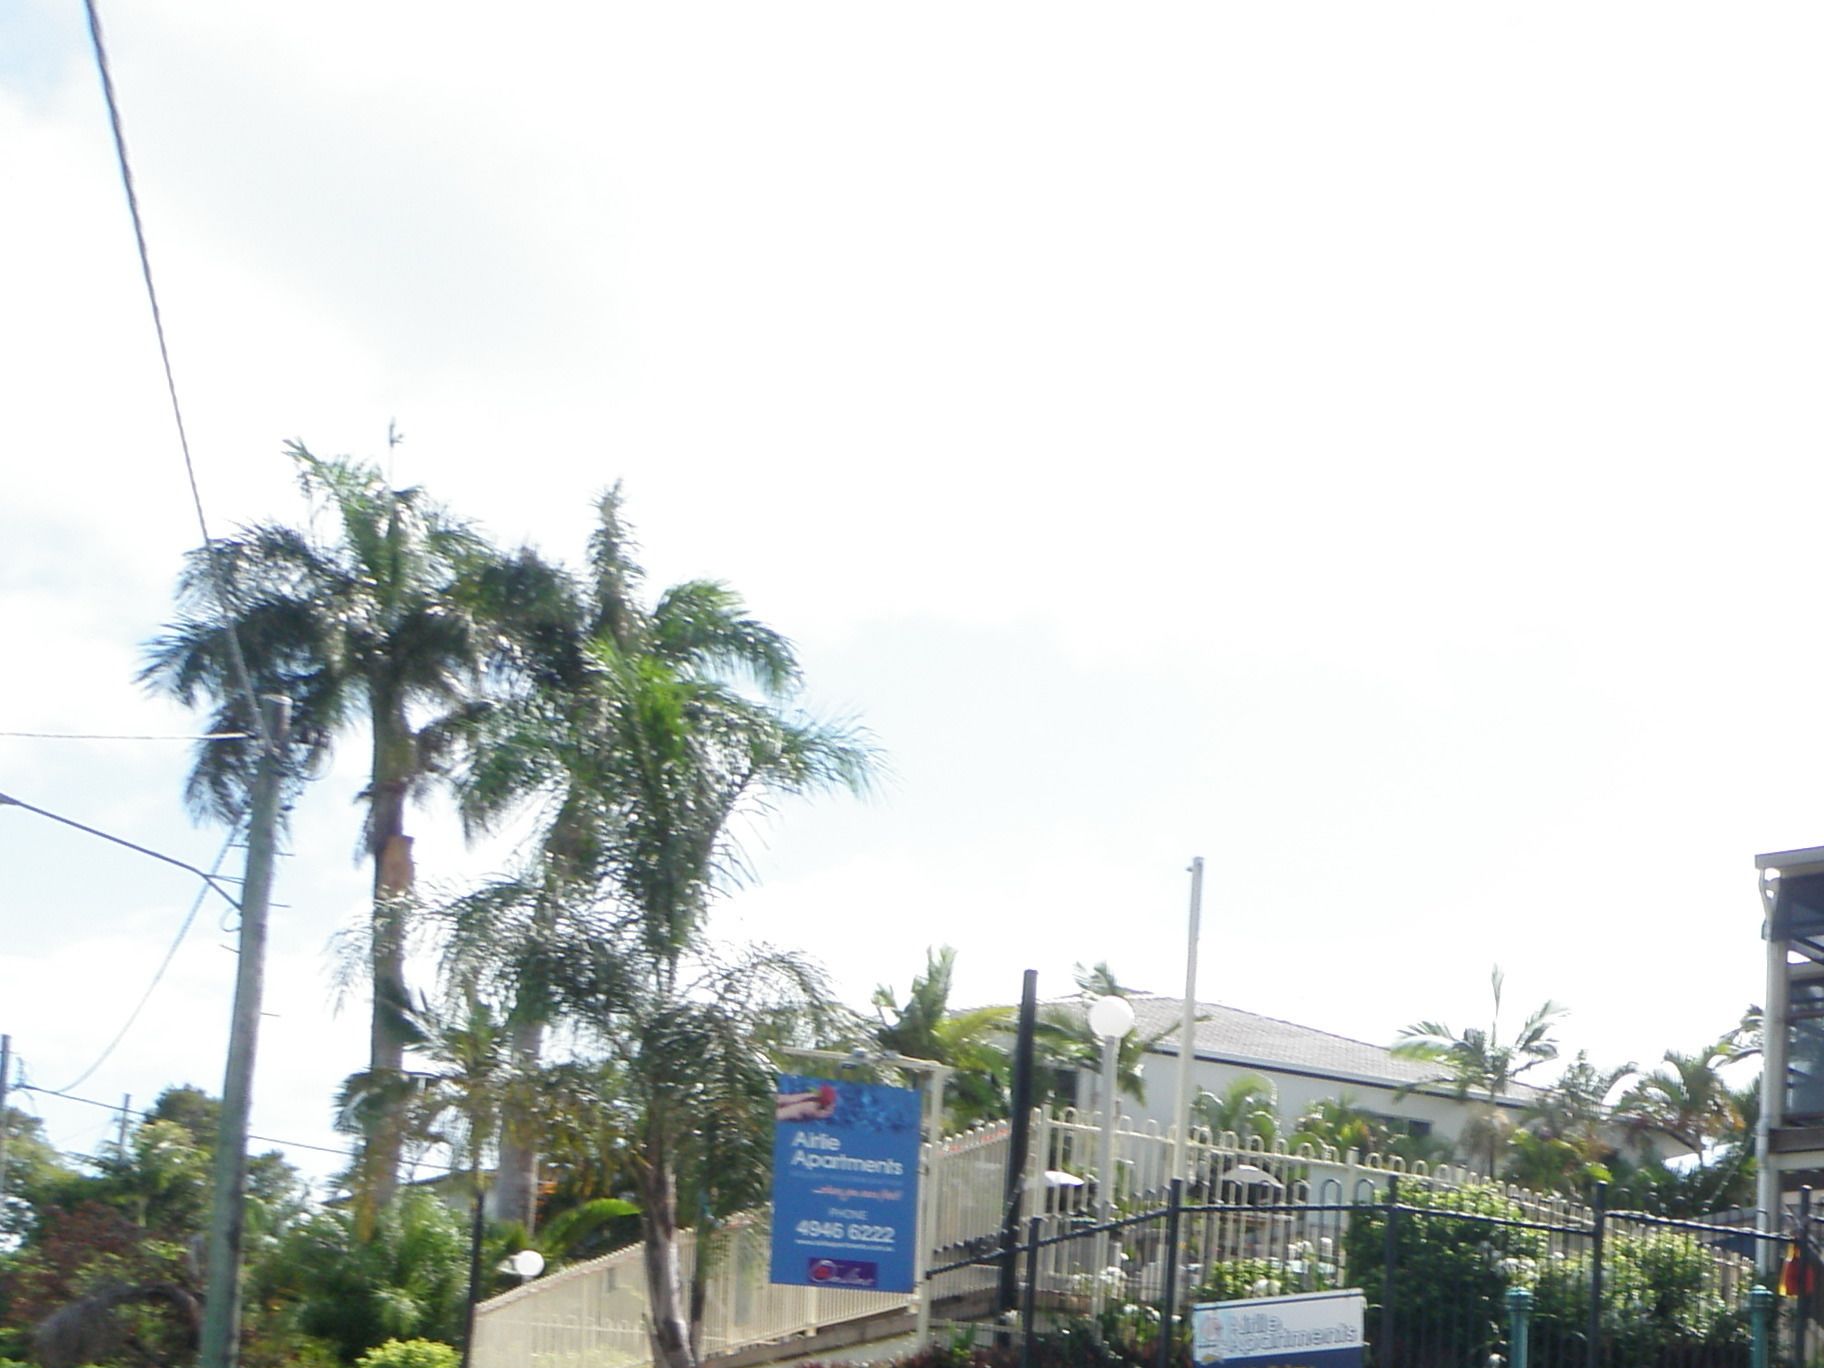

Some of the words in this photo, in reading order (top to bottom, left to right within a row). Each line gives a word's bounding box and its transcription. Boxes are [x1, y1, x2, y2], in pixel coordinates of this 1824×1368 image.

[791, 1131, 841, 1151] Airlie
[791, 1150, 903, 1175] Apartments
[796, 1220, 845, 1239] 4946
[847, 1223, 895, 1243] 6222
[1228, 1323, 1358, 1355] Apartments
